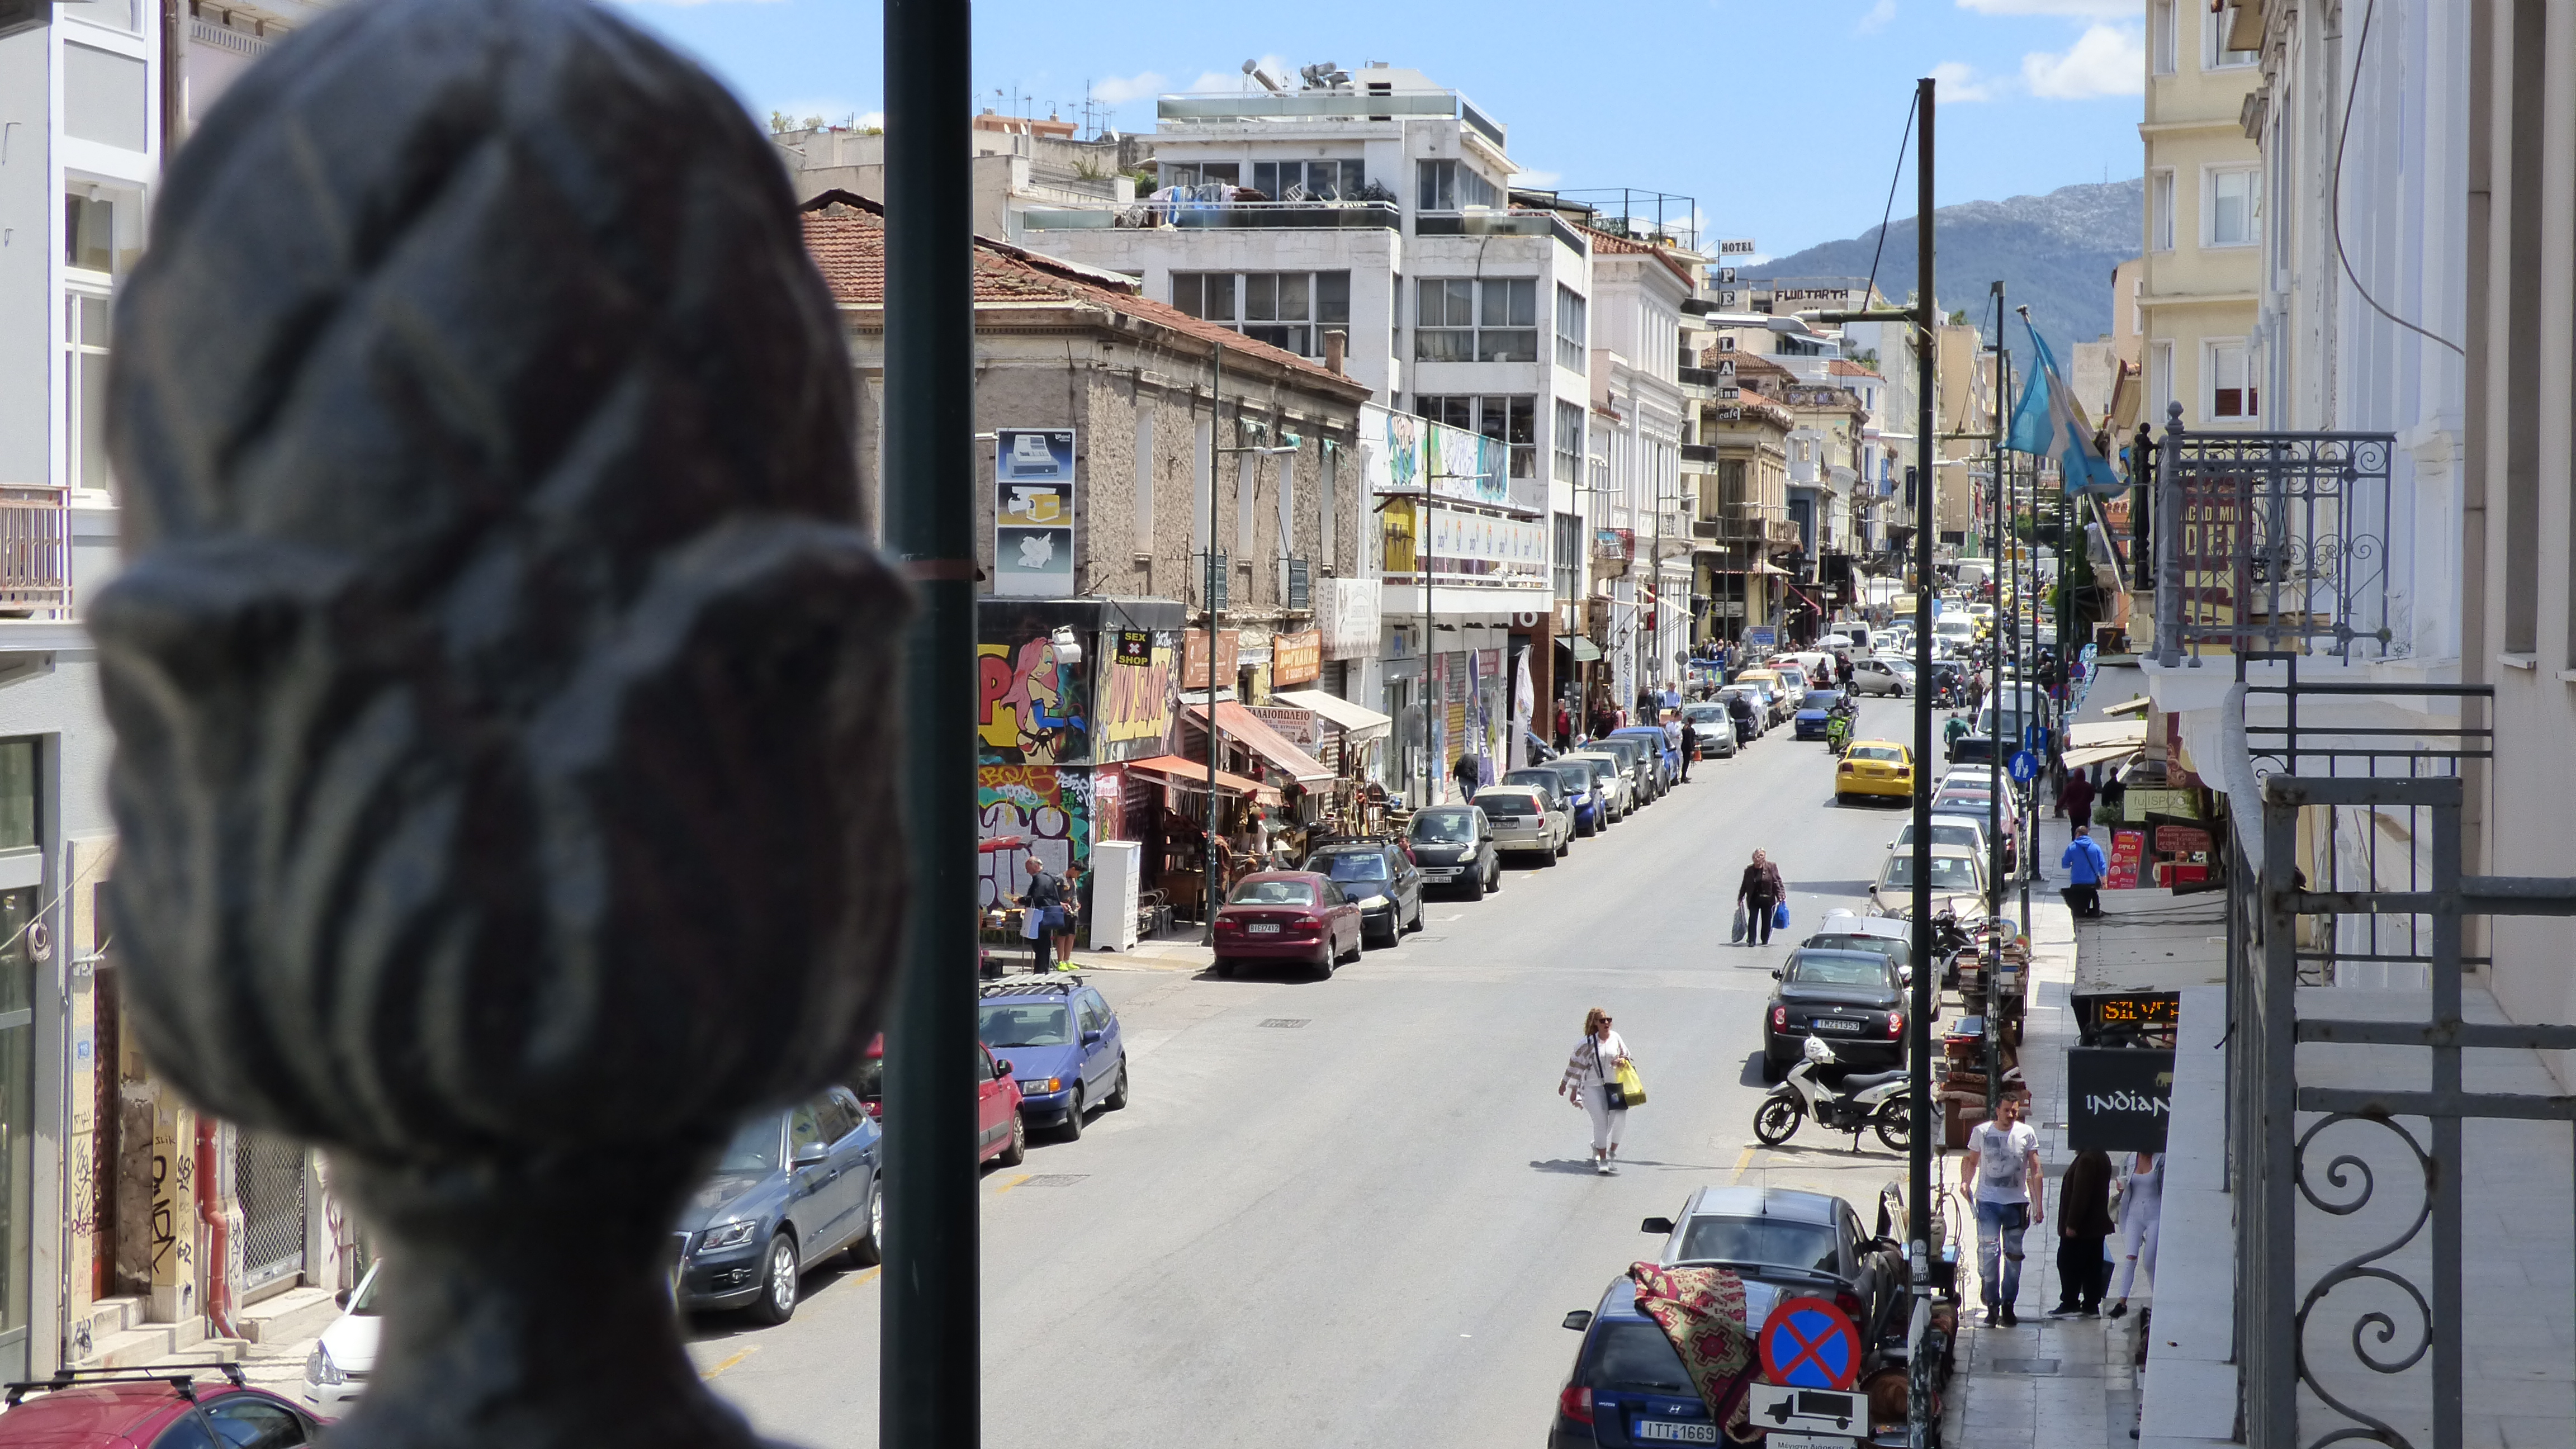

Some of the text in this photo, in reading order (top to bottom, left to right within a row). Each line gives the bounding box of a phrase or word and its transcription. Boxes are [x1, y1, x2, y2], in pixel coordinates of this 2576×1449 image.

[1721, 242, 1754, 252] HOTEL
[1720, 389, 1738, 398] inn
[1719, 409, 1737, 419] cafe
[1125, 632, 1146, 642] SEX
[1119, 655, 1148, 665] SHOP
[1246, 708, 1310, 721] ΑΛΑΙΟΠΩΛΕΙΟ
